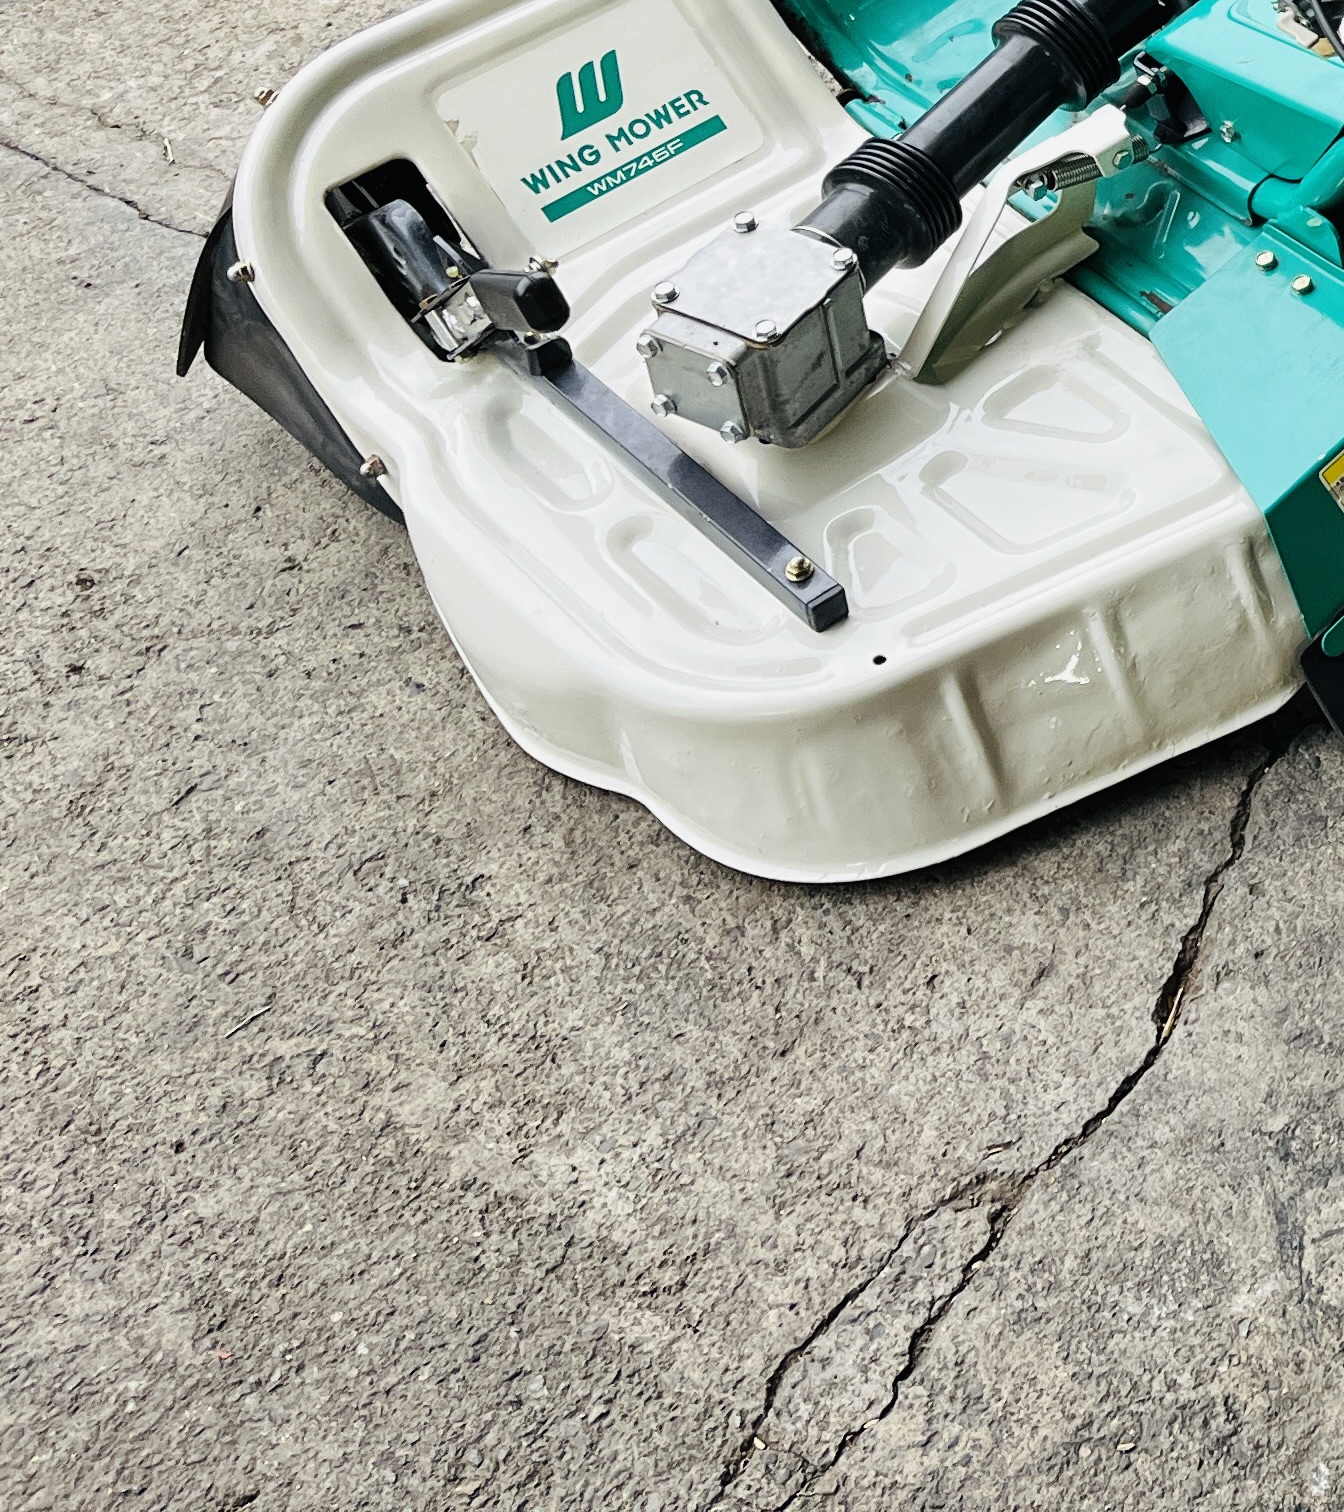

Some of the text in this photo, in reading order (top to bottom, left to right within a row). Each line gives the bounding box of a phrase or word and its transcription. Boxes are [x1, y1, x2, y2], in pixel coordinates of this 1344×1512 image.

[520, 89, 710, 195] WING MOWER
[586, 138, 684, 196] WM746F
